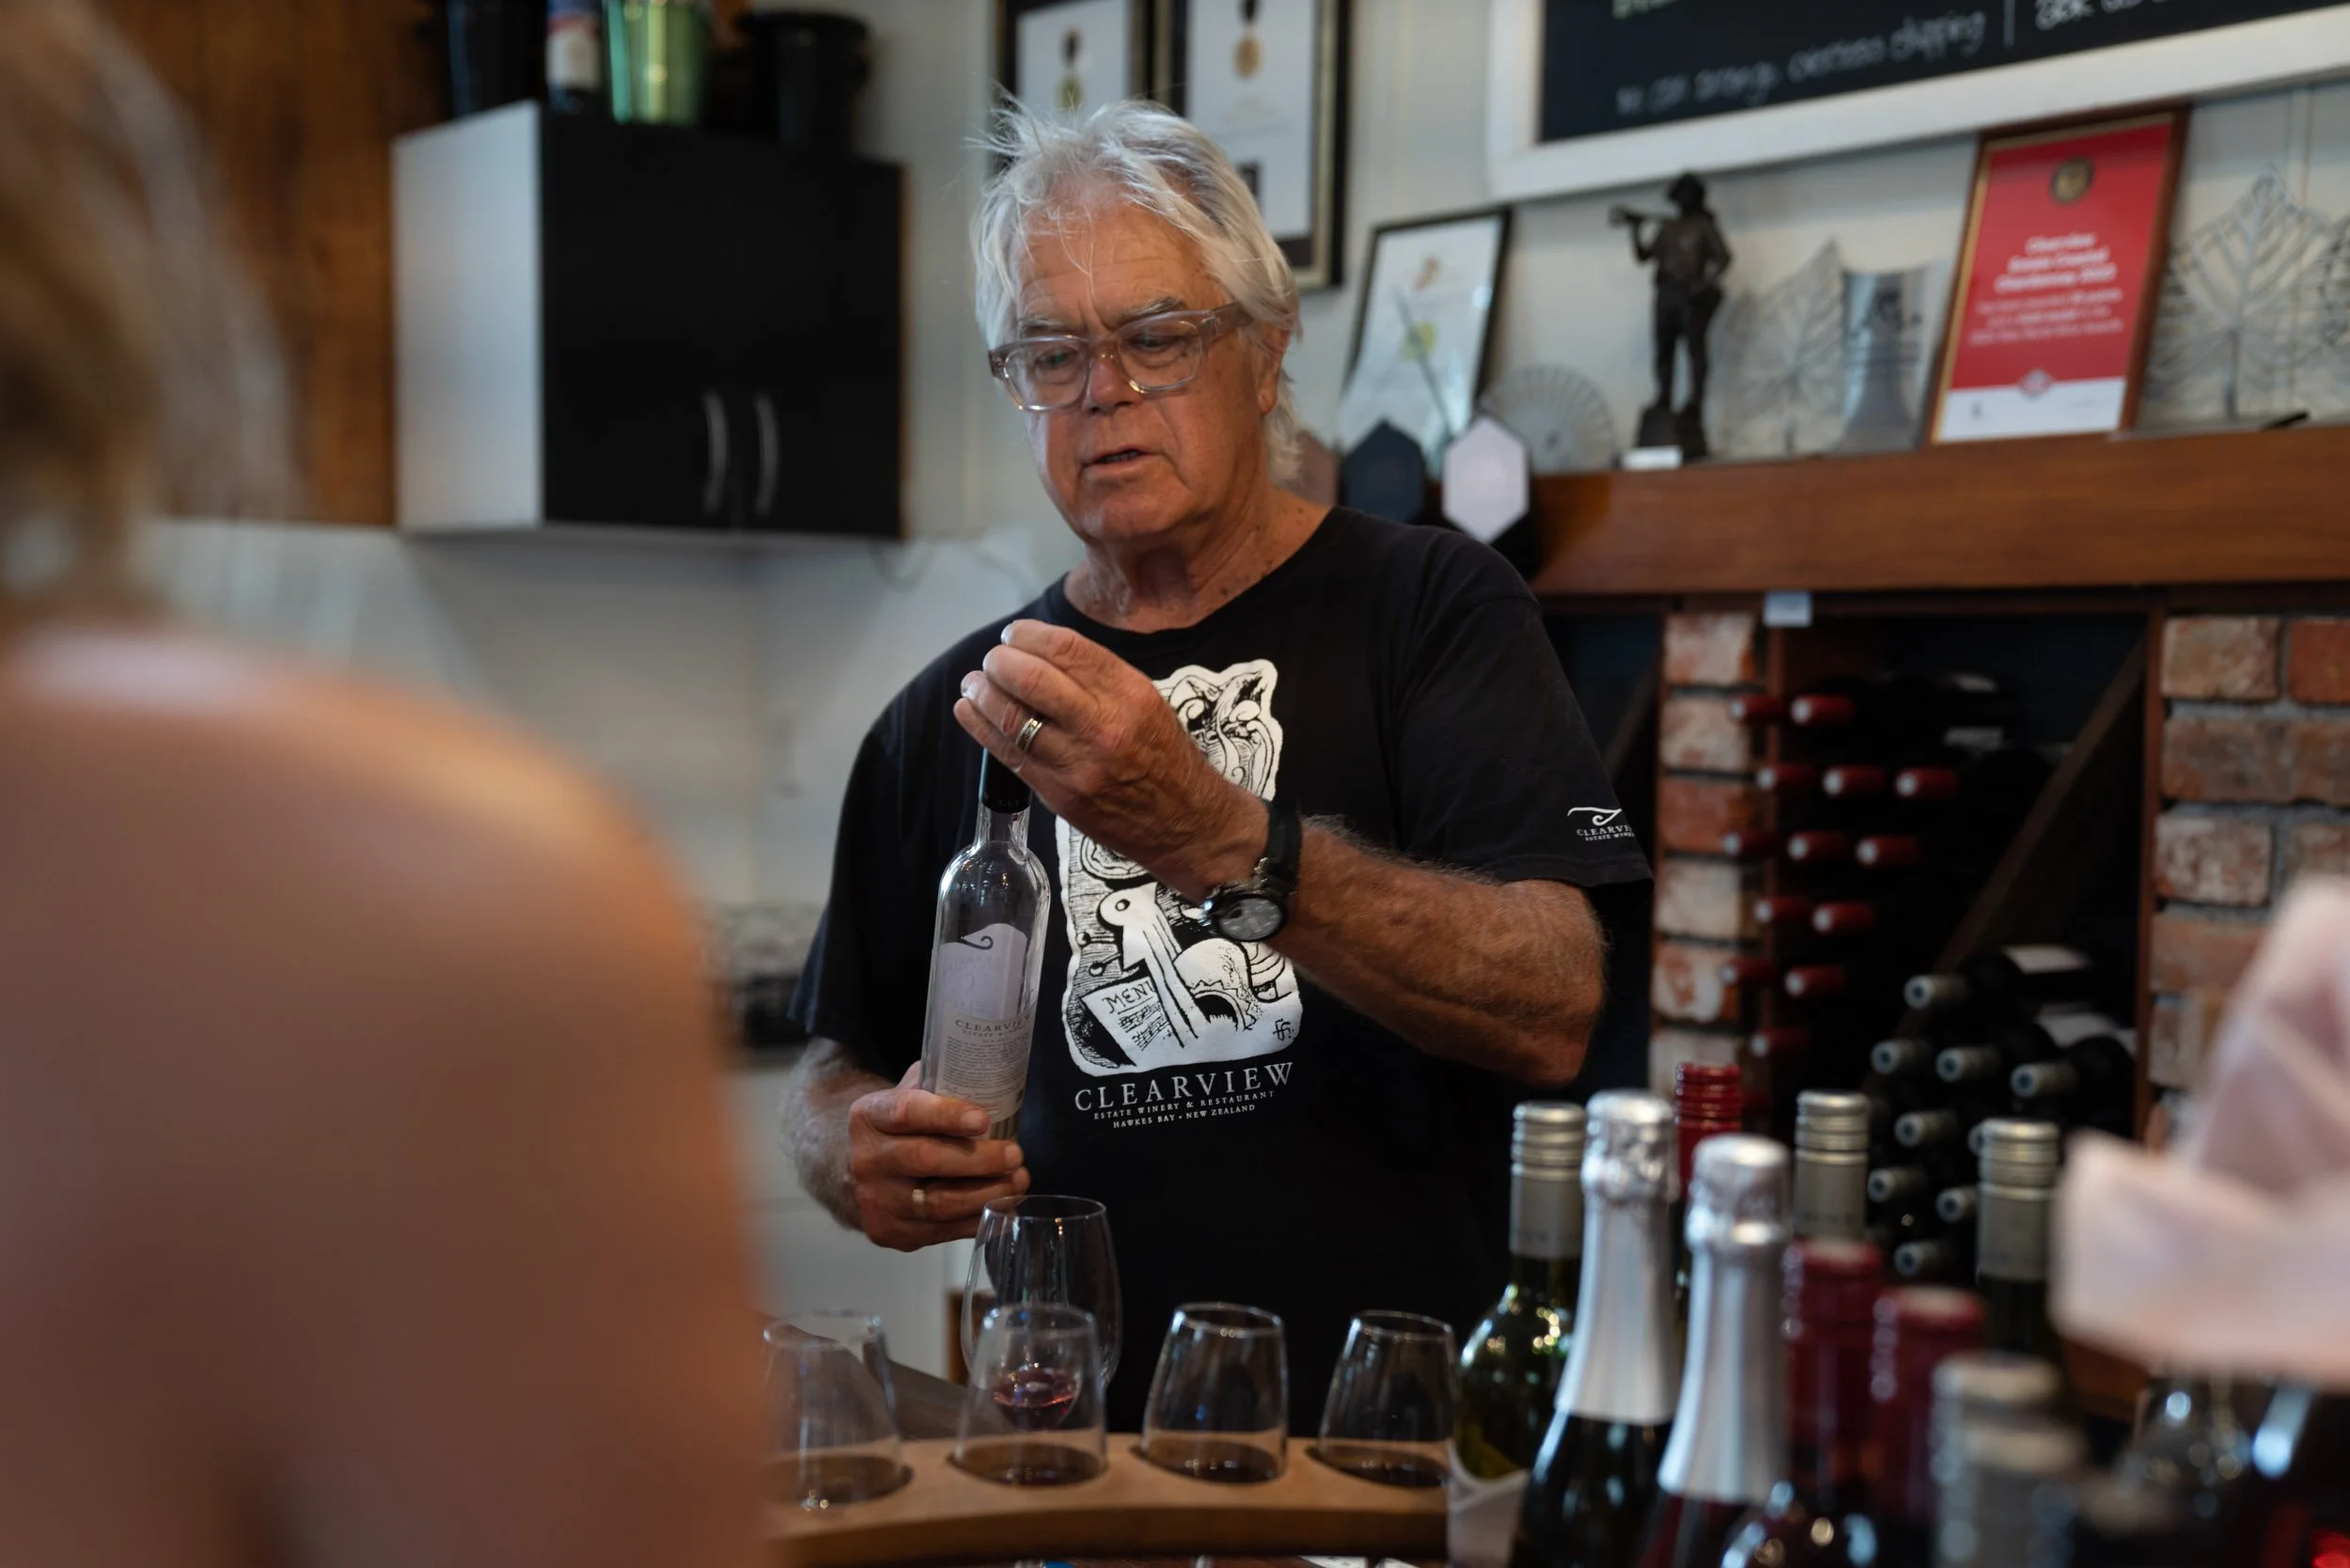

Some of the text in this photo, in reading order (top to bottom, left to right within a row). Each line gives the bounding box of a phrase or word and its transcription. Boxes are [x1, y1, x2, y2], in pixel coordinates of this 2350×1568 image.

[1074, 1062, 1293, 1111] CLEARVIEW
[1093, 1108, 1132, 1120] ESTATE
[1137, 1103, 1179, 1114] WINERY
[1200, 1090, 1276, 1106] RESTAURANT
[1113, 1104, 1255, 1128] HAWKES BAY NEW ZEALAND
